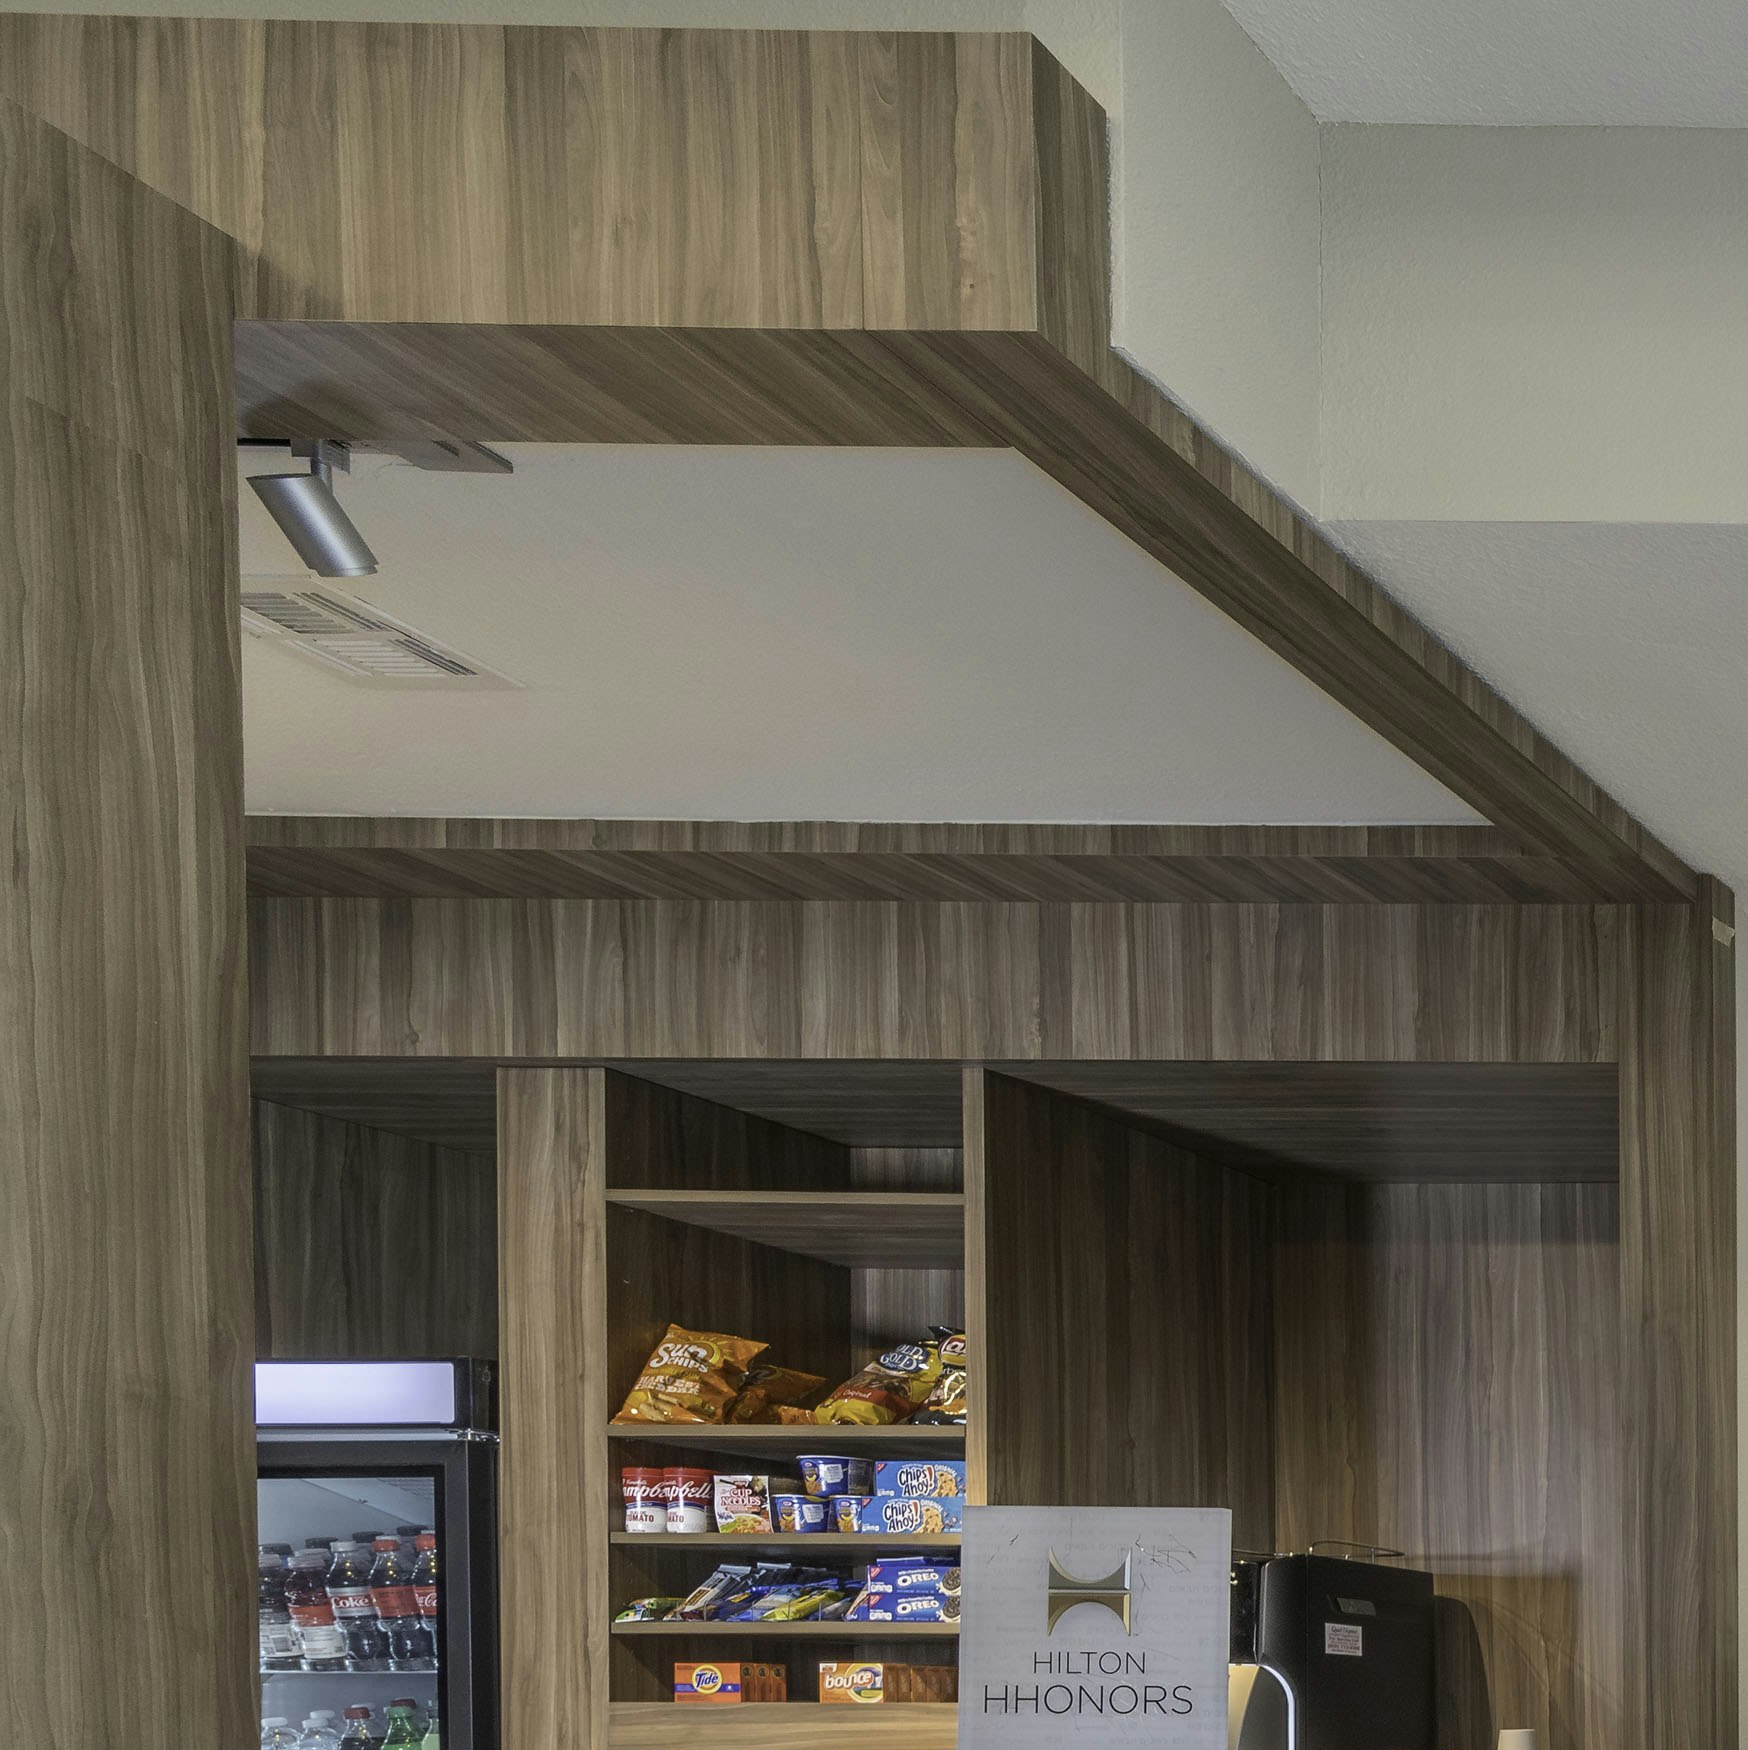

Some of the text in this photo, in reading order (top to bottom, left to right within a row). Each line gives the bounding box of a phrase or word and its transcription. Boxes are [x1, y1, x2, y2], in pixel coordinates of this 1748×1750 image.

[880, 1352, 918, 1371] GOLD
[729, 1488, 752, 1497] CUP
[721, 1496, 761, 1506] NOODLES
[897, 1572, 939, 1587] OREO
[332, 1596, 369, 1608] Coke
[897, 1600, 939, 1614] OREO
[1033, 1651, 1146, 1674] HILTON
[695, 1671, 719, 1687] Tide
[825, 1672, 872, 1689] bounce
[984, 1684, 1193, 1715] HHONORS
